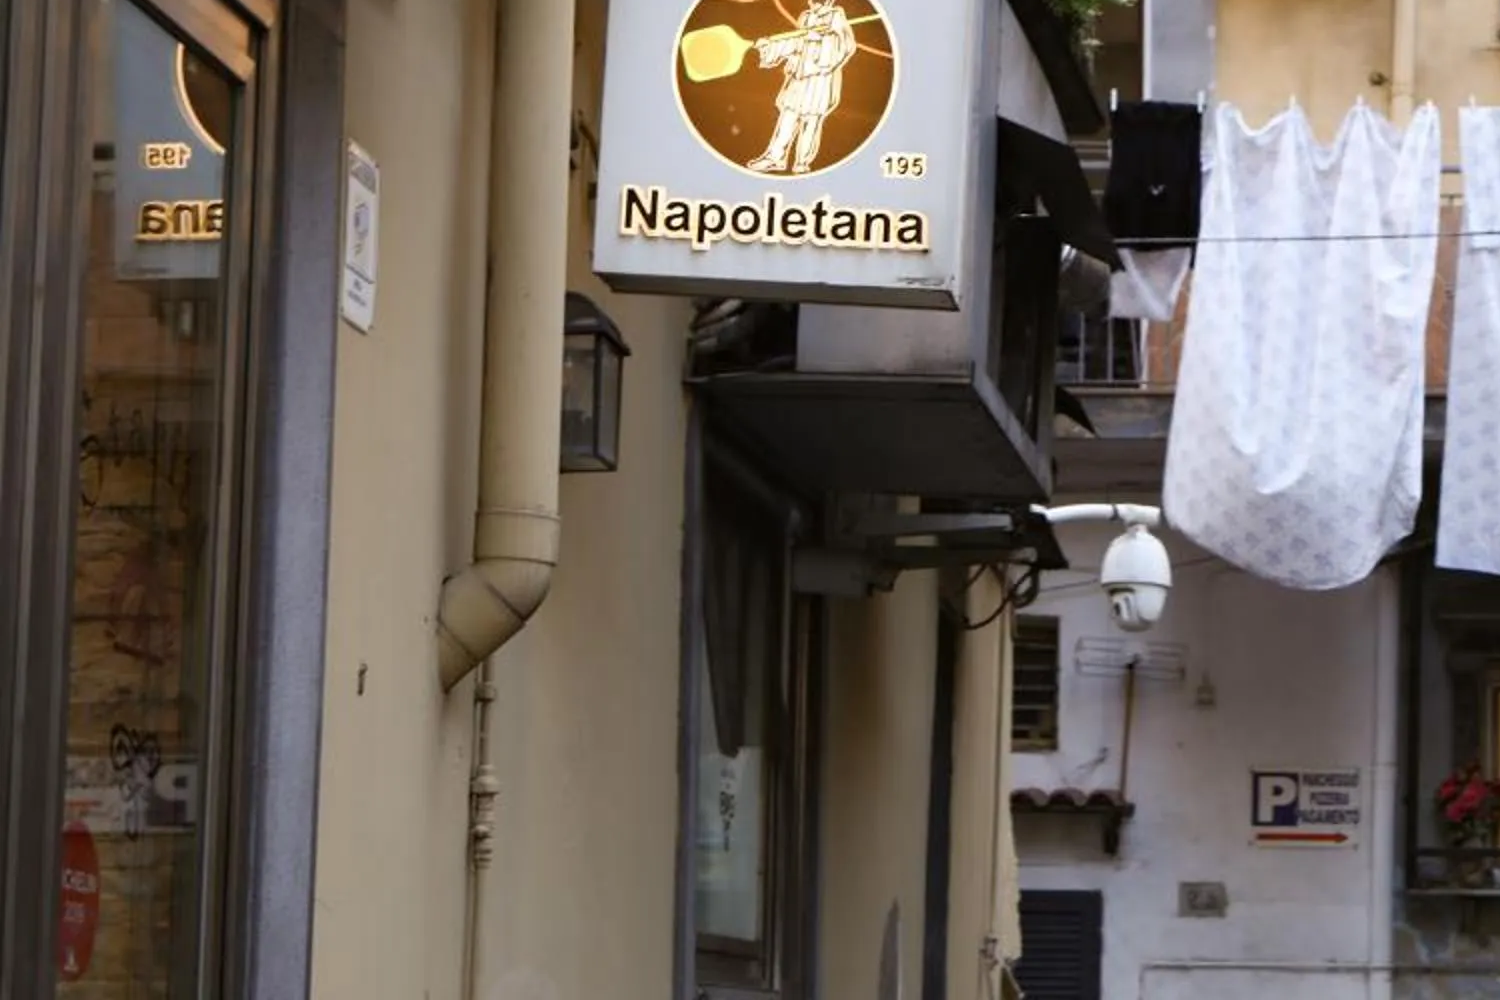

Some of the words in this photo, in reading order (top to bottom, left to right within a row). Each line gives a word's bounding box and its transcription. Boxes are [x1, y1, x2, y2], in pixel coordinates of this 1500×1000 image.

[883, 154, 925, 178] 195
[621, 187, 926, 246] Napoletana
[1257, 776, 1298, 824] P
